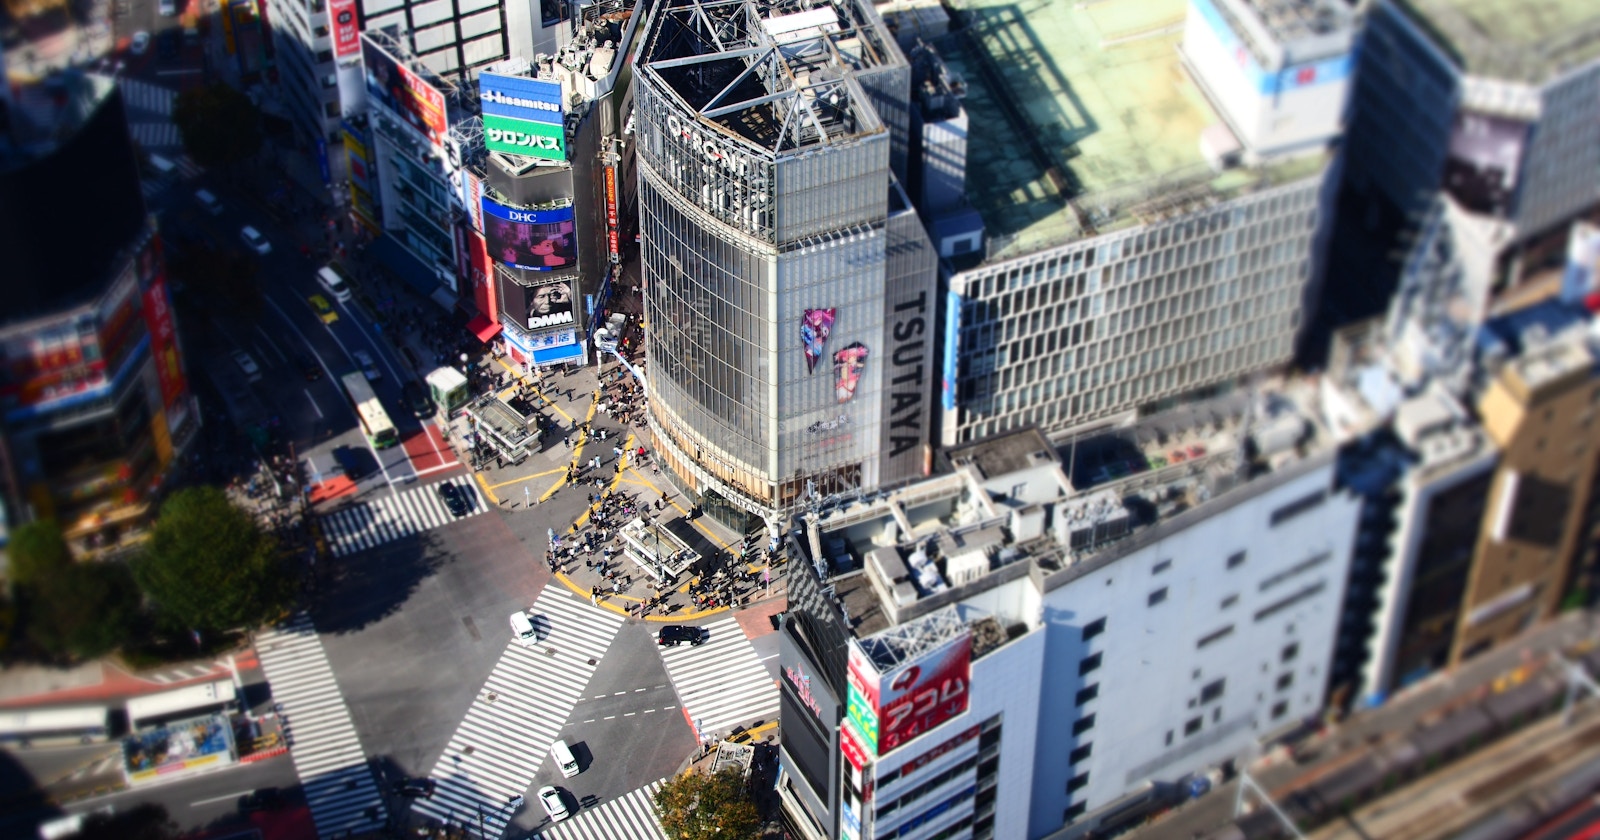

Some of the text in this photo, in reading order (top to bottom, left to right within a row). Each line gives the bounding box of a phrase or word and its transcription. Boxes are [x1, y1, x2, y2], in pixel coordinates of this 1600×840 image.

[480, 89, 560, 112] Hisamitsu
[487, 127, 561, 152] サロンパス
[509, 210, 537, 223] DHC
[528, 310, 573, 329] DMM
[889, 290, 927, 458] TSUTAYA
[721, 489, 766, 517] TSUTAYA
[849, 687, 878, 728] レイク
[886, 676, 965, 732] アコム
